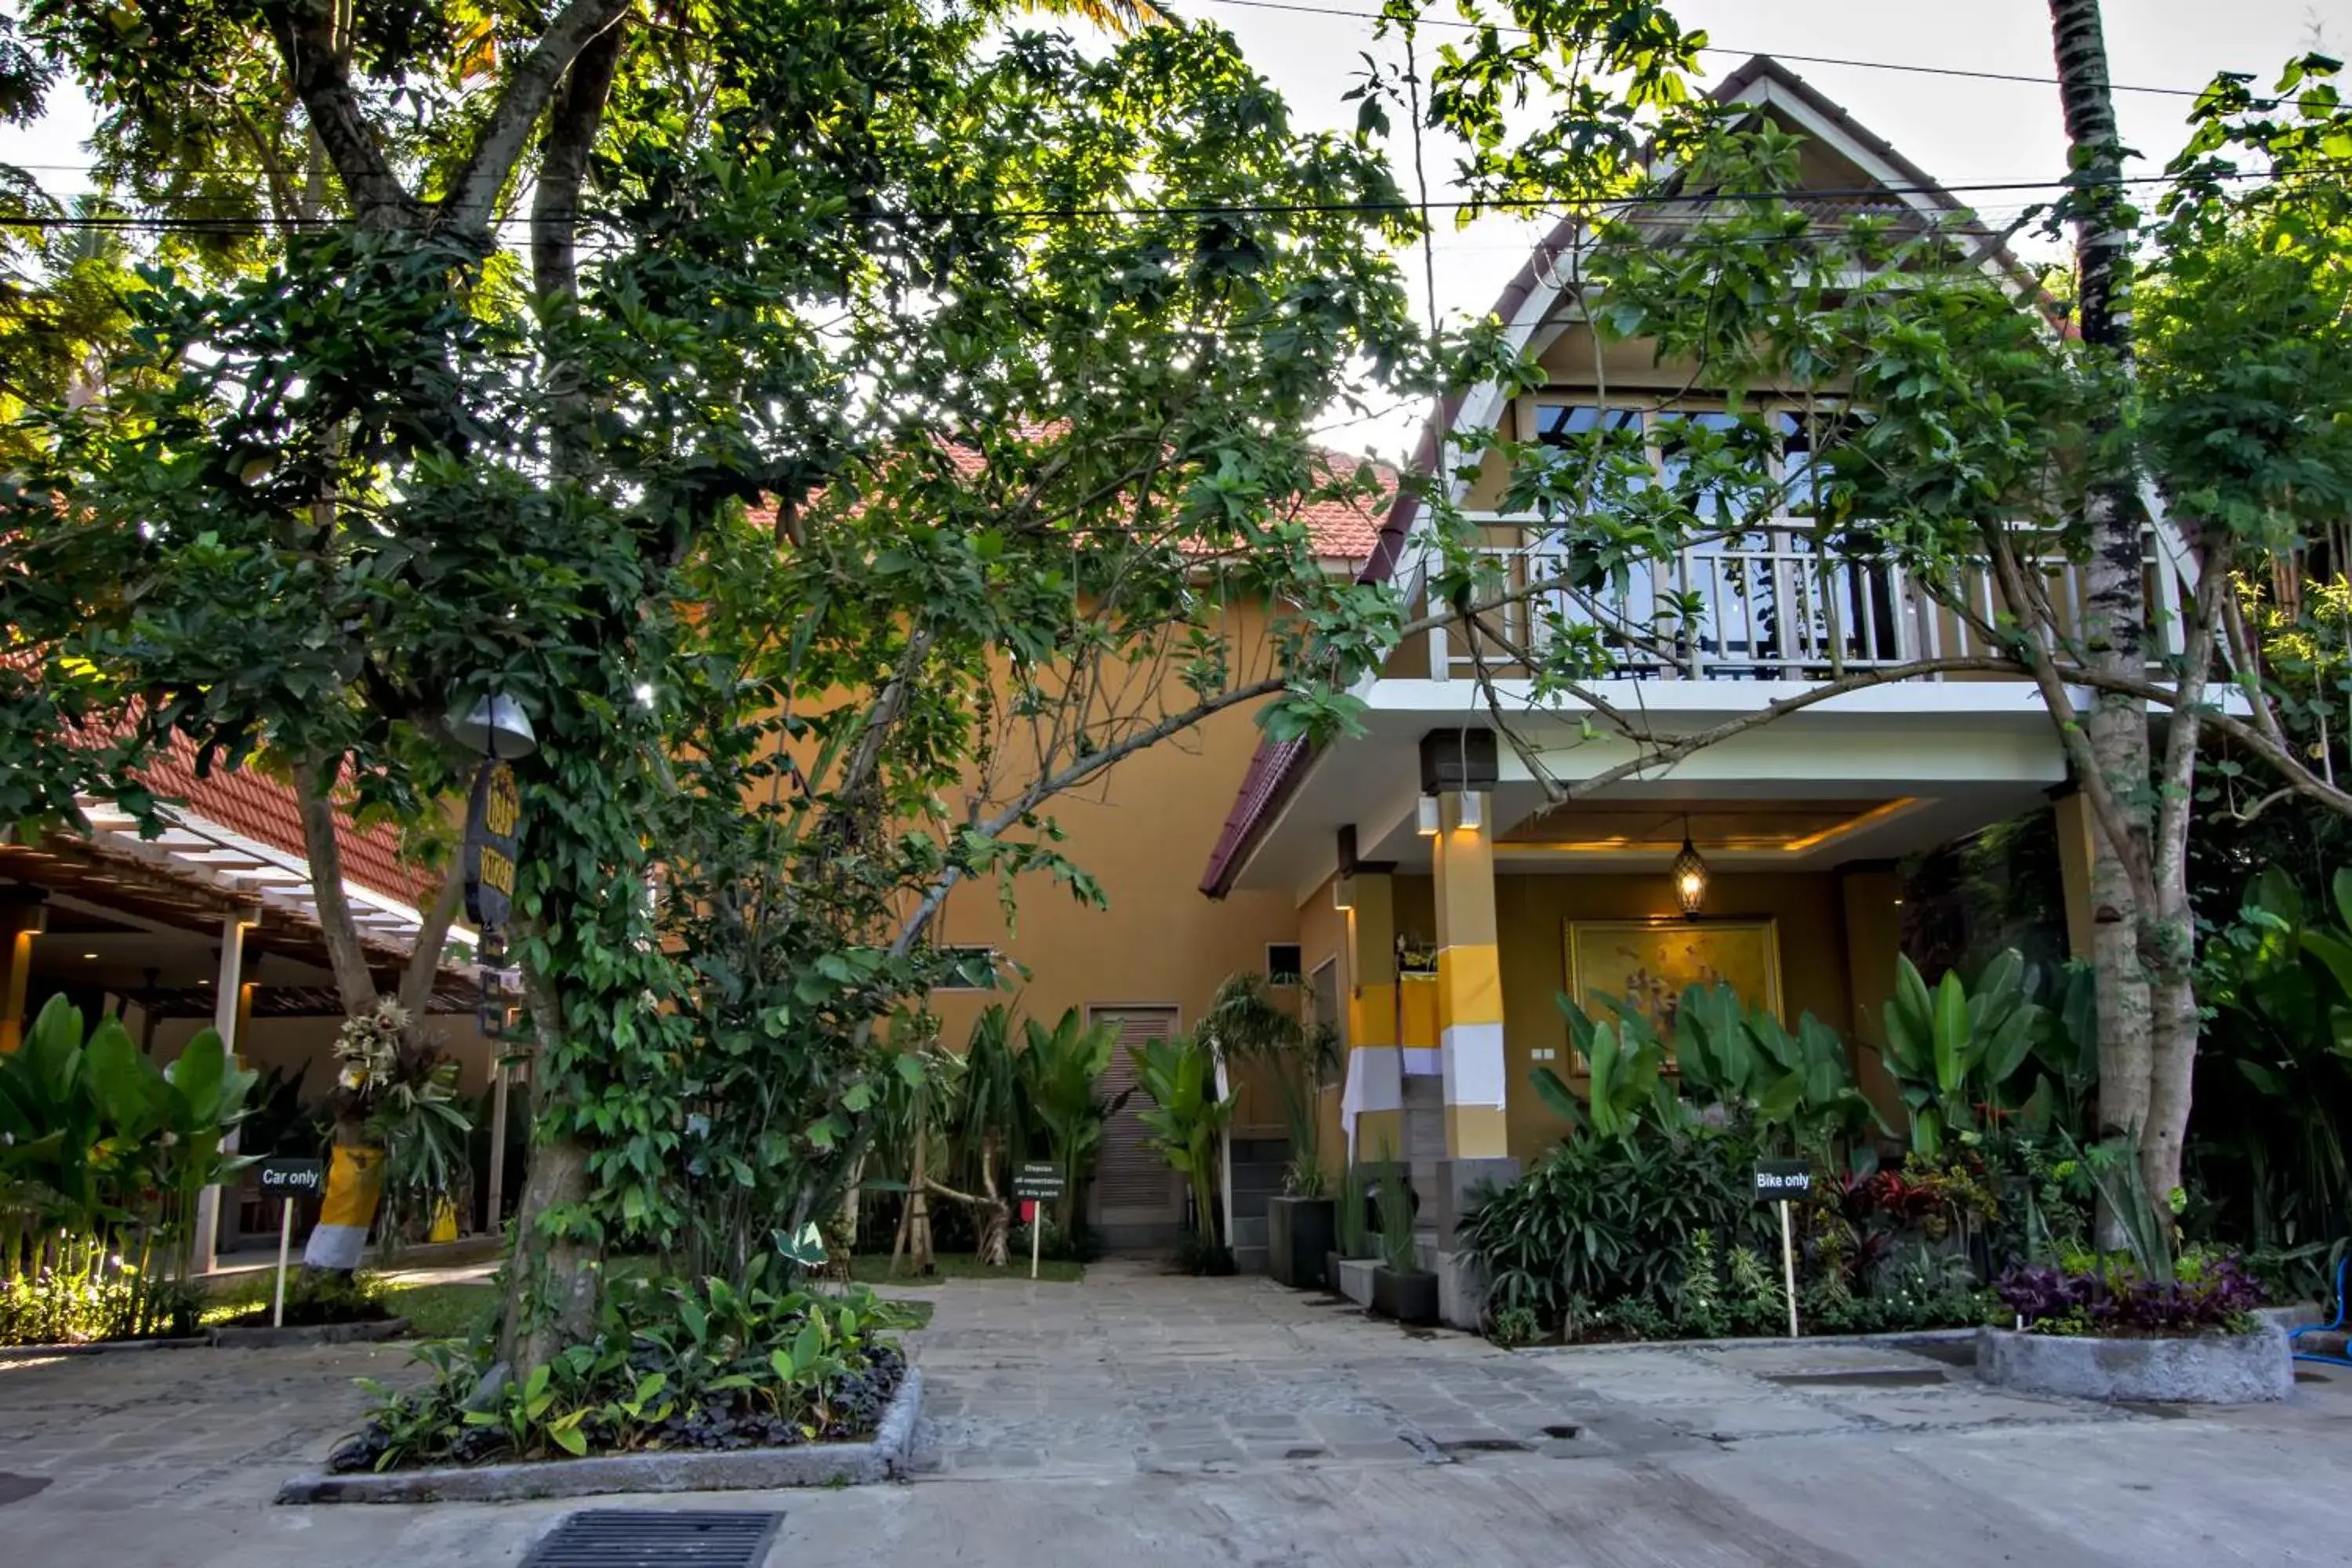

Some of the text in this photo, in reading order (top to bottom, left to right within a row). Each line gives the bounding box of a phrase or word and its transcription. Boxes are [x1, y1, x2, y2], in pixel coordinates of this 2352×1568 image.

[263, 1169, 318, 1189] Car only
[1757, 1172, 1809, 1190] Bike only
